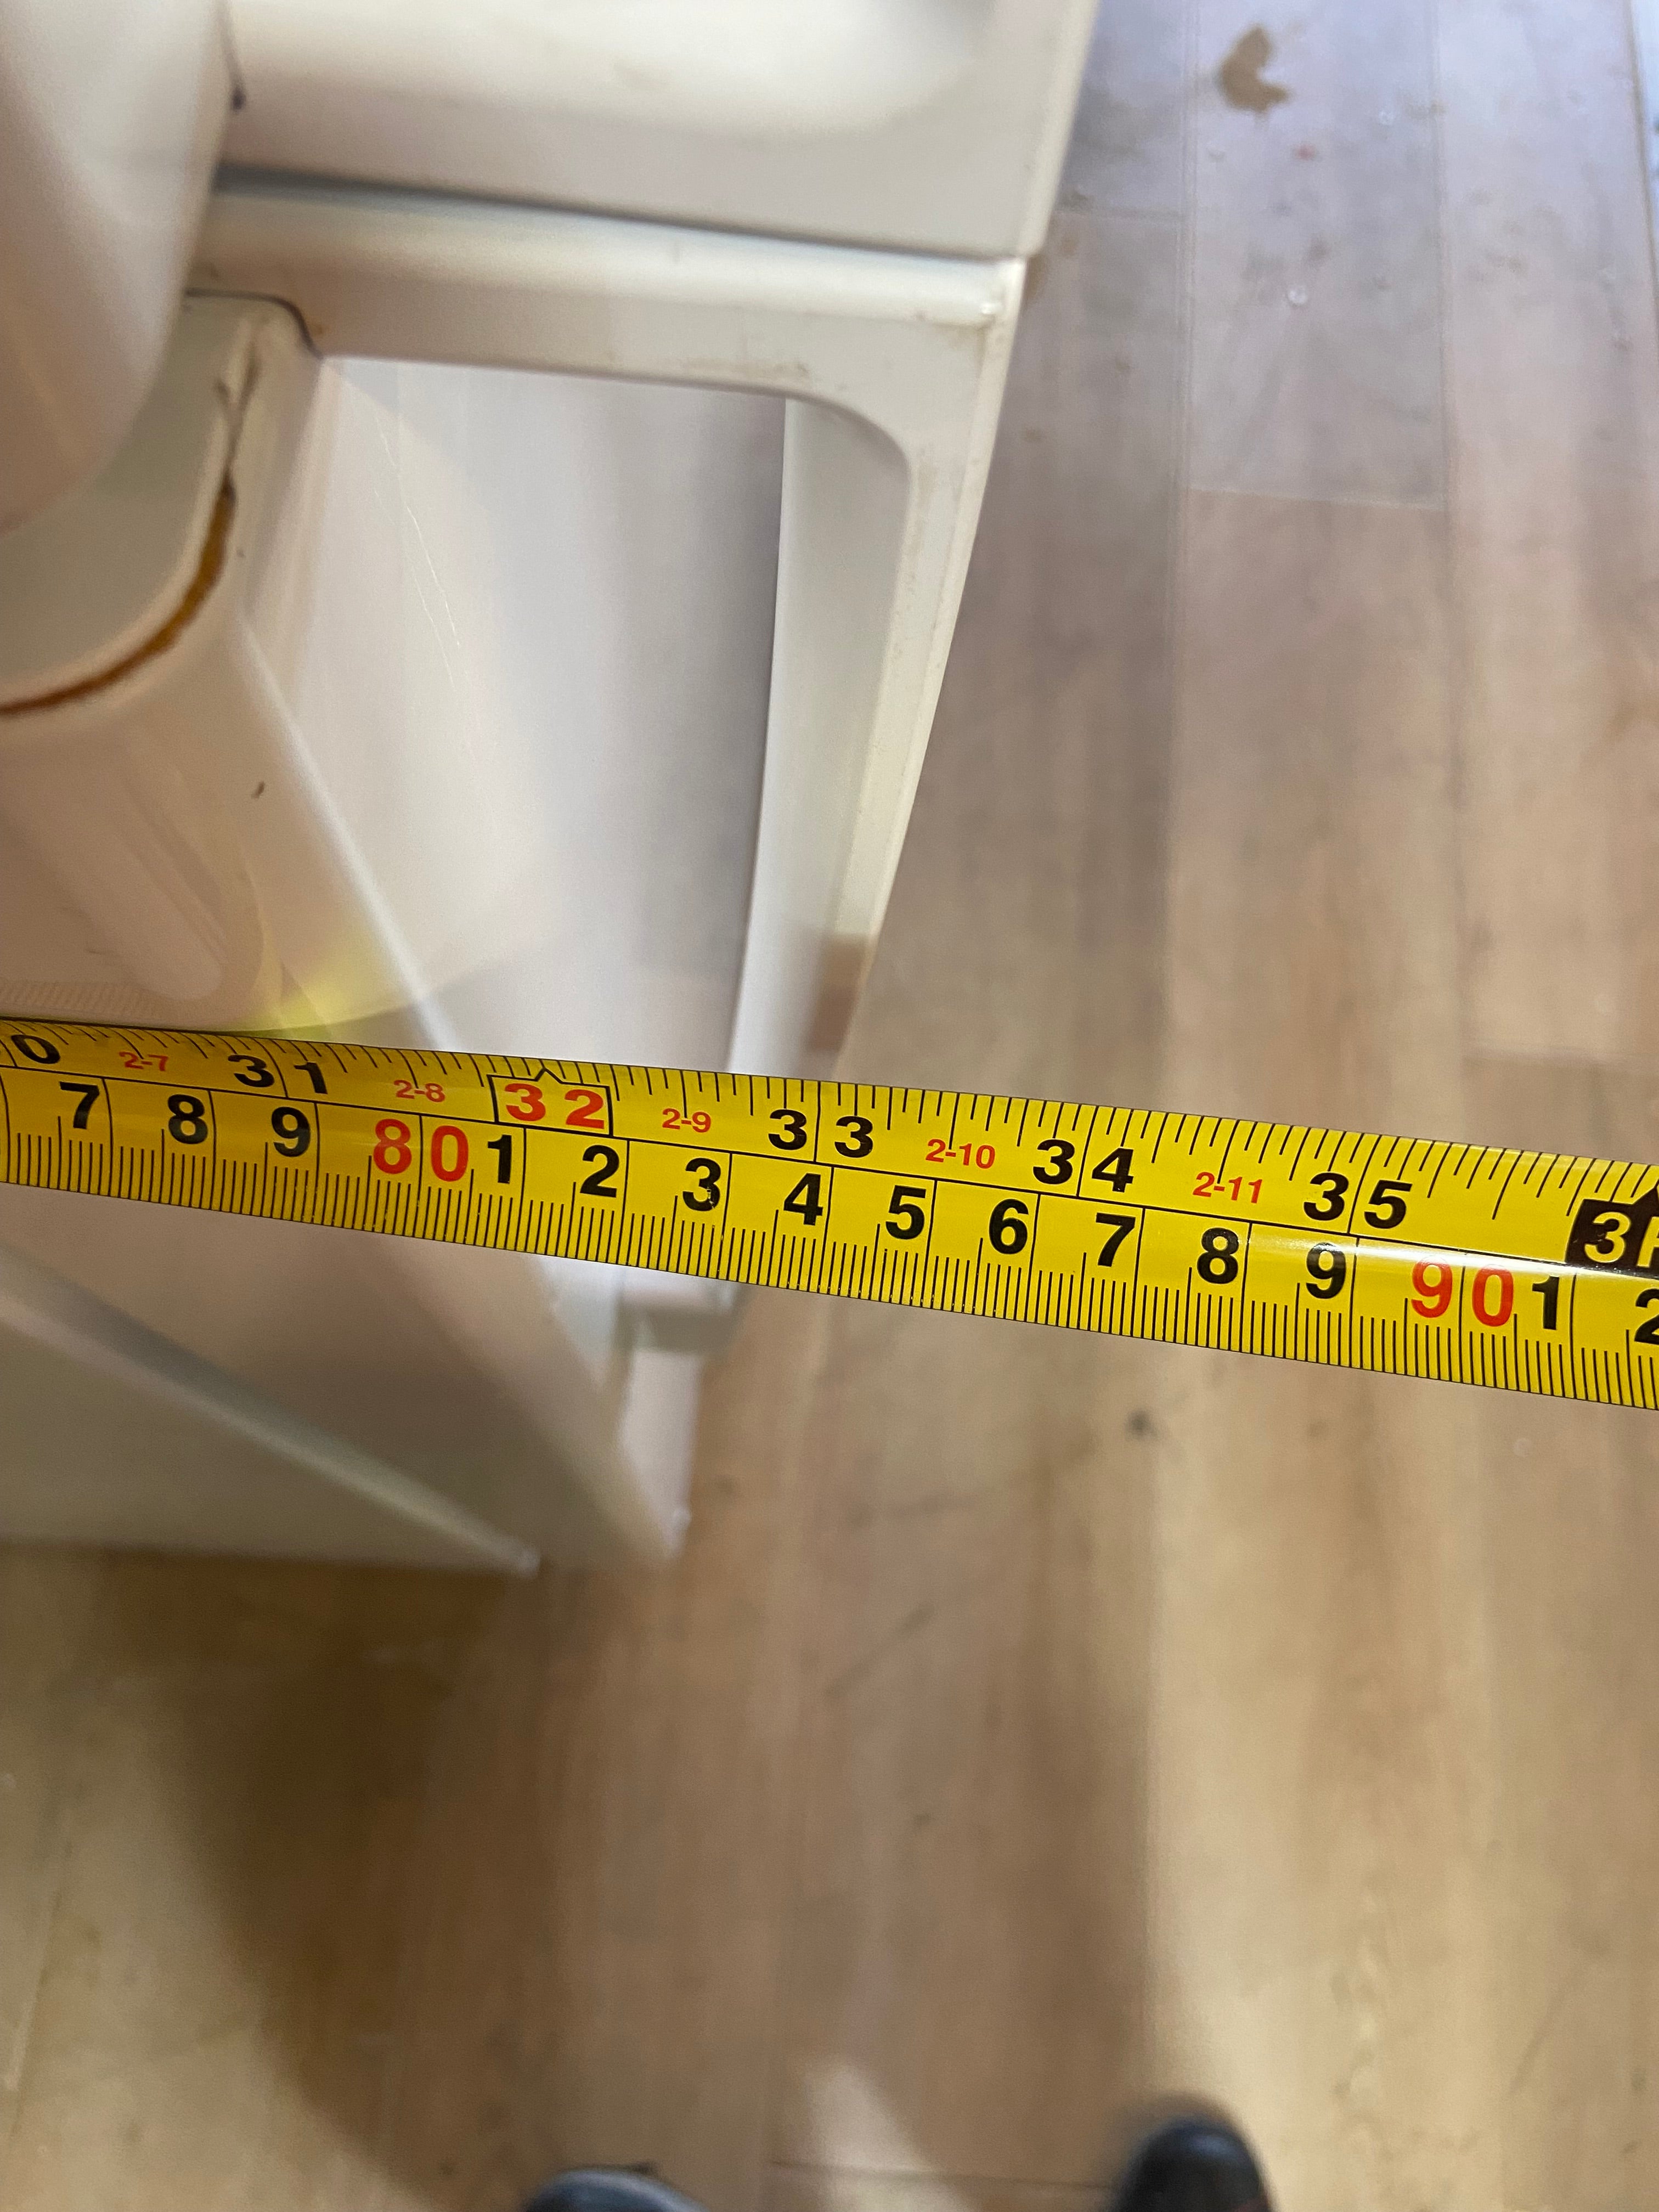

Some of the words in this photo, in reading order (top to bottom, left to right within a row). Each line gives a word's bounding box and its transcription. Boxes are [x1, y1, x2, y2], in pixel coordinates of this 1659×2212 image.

[59, 1081, 99, 1130] 7
[167, 1093, 208, 1144] 8
[271, 1106, 311, 1158] 9
[373, 1118, 469, 1182] 80
[487, 1134, 512, 1184] 1
[580, 1144, 620, 1198] 2
[682, 1157, 721, 1212] 3
[783, 1172, 823, 1226] 4
[885, 1184, 927, 1240] 5
[989, 1198, 1029, 1255] 6
[1096, 1212, 1136, 1267] 7
[1197, 1227, 1240, 1284] 8
[1306, 1242, 1346, 1299] 9
[1410, 1256, 1514, 1327] 90
[1532, 1275, 1559, 1330] 1
[119, 1051, 168, 1071] 2-7
[393, 1079, 445, 1103] 2-8
[504, 1082, 605, 1130] 32
[662, 1108, 711, 1133] 2-9
[926, 1138, 996, 1169] 2-10
[1193, 1172, 1263, 1204] 2-11
